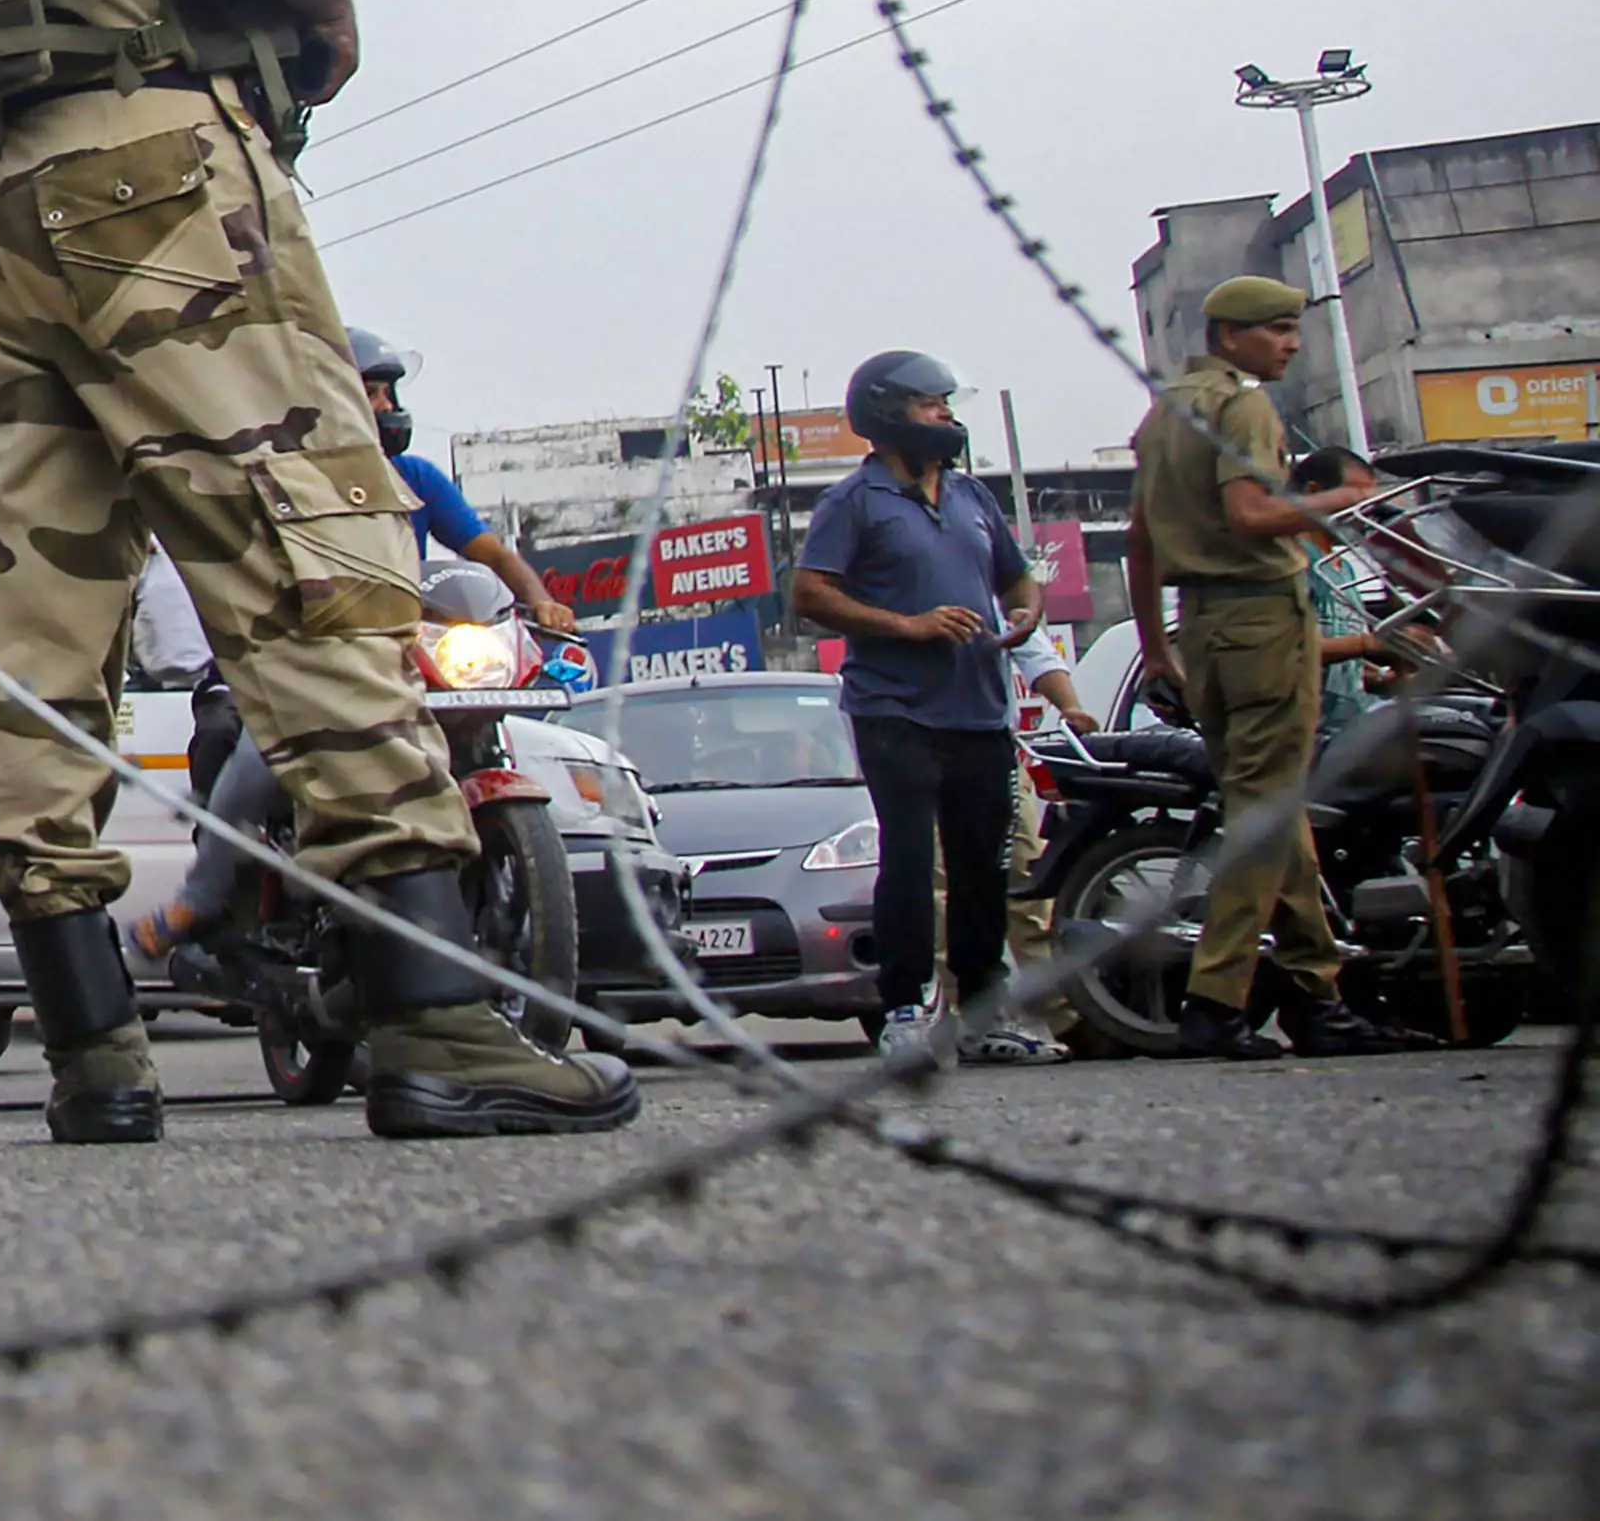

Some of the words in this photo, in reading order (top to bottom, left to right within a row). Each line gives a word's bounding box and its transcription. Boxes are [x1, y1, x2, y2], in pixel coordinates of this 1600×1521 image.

[660, 526, 748, 561] BAKER'S
[671, 563, 750, 596] AVENUE
[630, 641, 748, 683] BAKER'S
